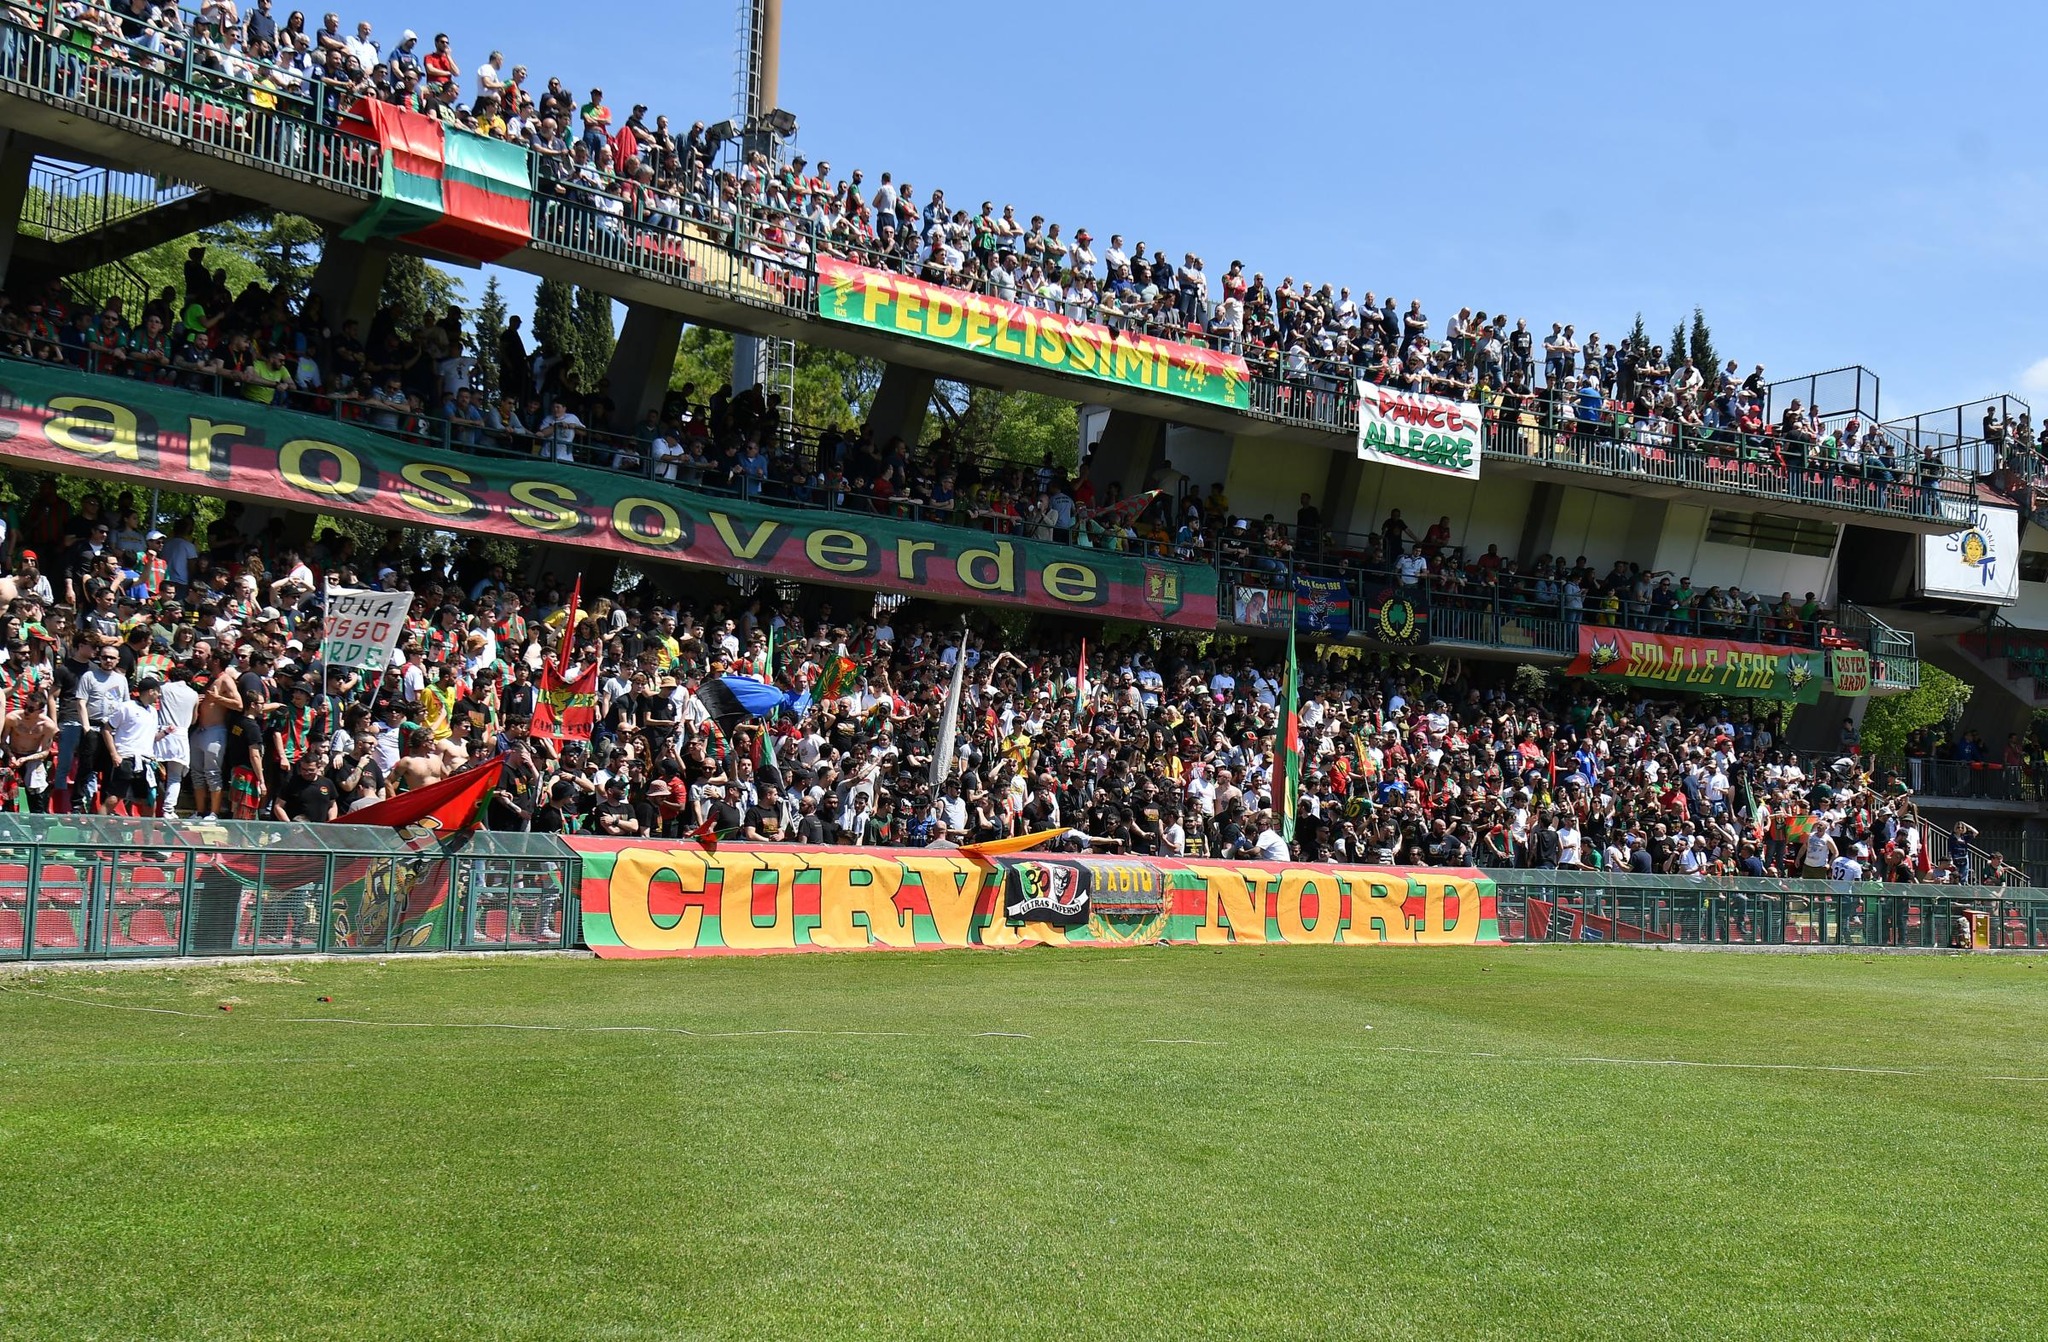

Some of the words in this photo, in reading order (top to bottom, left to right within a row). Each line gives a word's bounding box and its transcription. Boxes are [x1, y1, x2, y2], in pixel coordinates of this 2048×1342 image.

[863, 272, 1170, 388] FEDELISSIMI
[1184, 359, 1206, 384] 74
[1377, 390, 1464, 432] PANCE
[1363, 421, 1474, 468] ALLEGRE
[1985, 529, 1996, 553] ITALIA
[1268, 589, 1293, 610] GIANN
[1624, 642, 1684, 682] SOLO
[1685, 649, 1718, 684] LE
[1720, 651, 1778, 689] FERE
[1833, 866, 1846, 881] 32
[1022, 899, 1050, 913] ULTRAS
[1051, 902, 1081, 914] INFERNO
[1186, 865, 1482, 944] NORD
